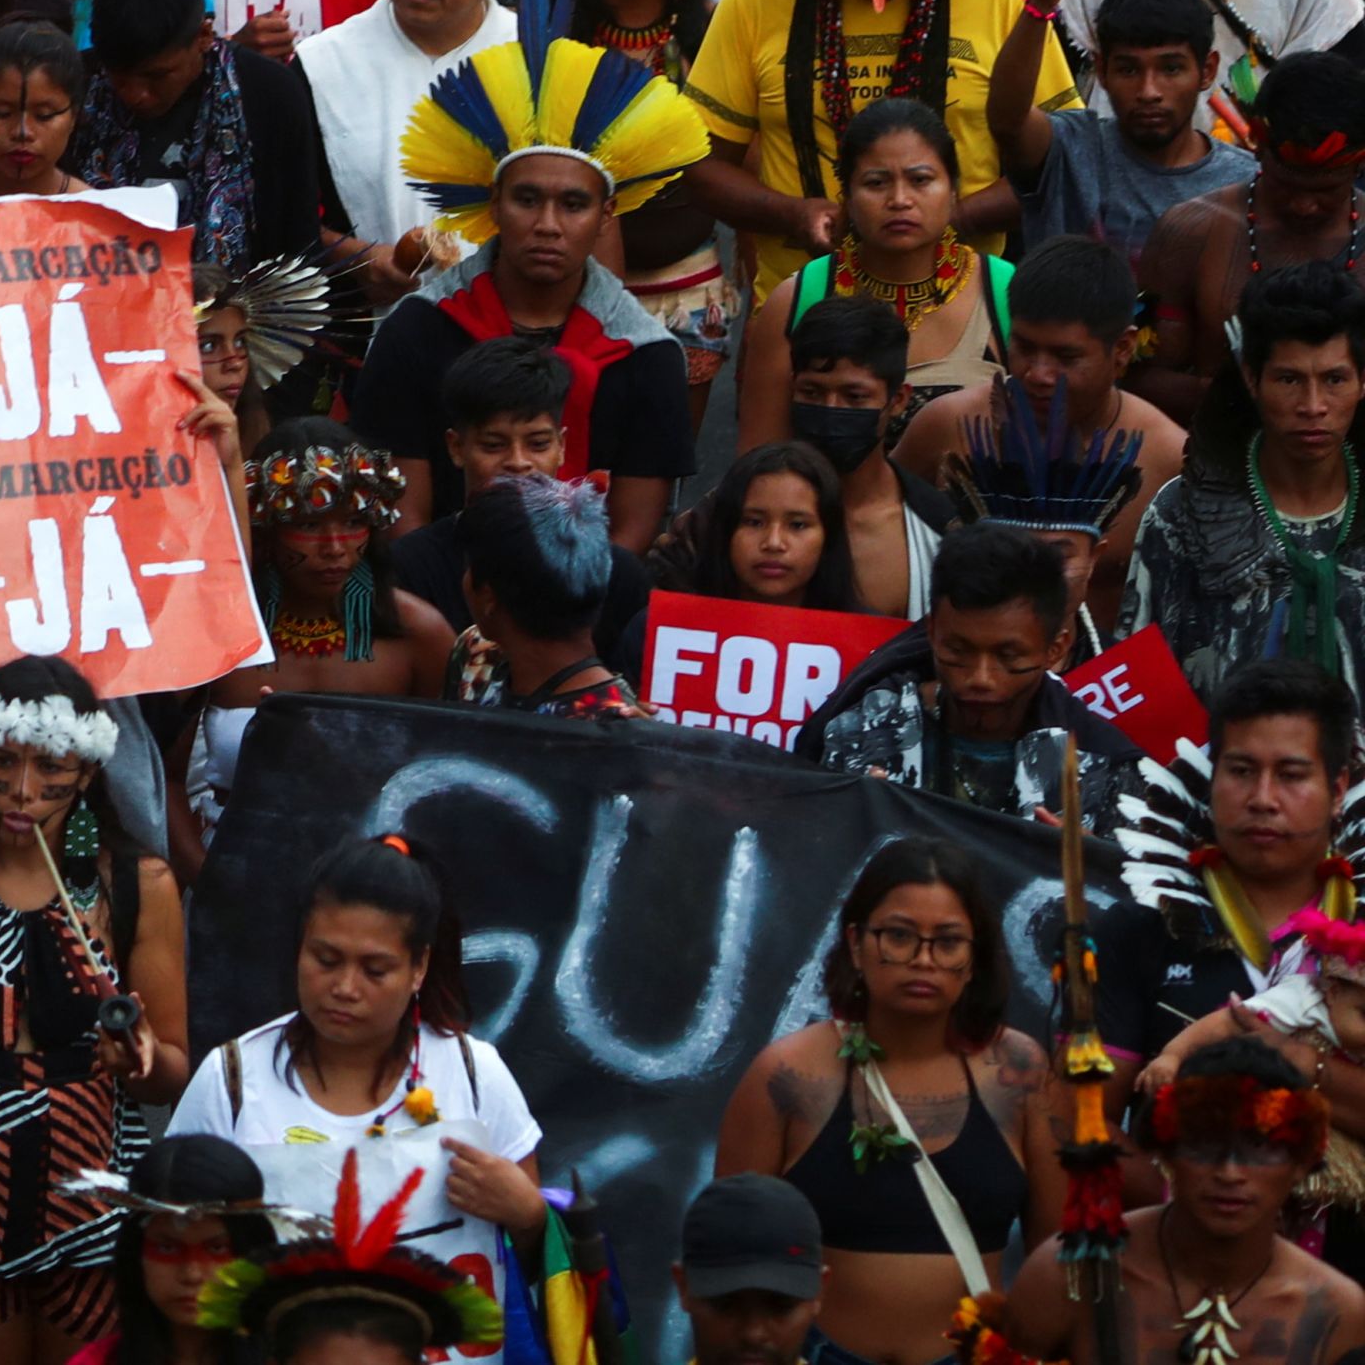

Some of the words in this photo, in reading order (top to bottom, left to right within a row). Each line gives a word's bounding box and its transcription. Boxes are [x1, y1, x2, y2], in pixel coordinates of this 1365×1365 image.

[3, 495, 154, 656] JÁ
[651, 625, 841, 724] FOR
[1072, 662, 1146, 720] RE
